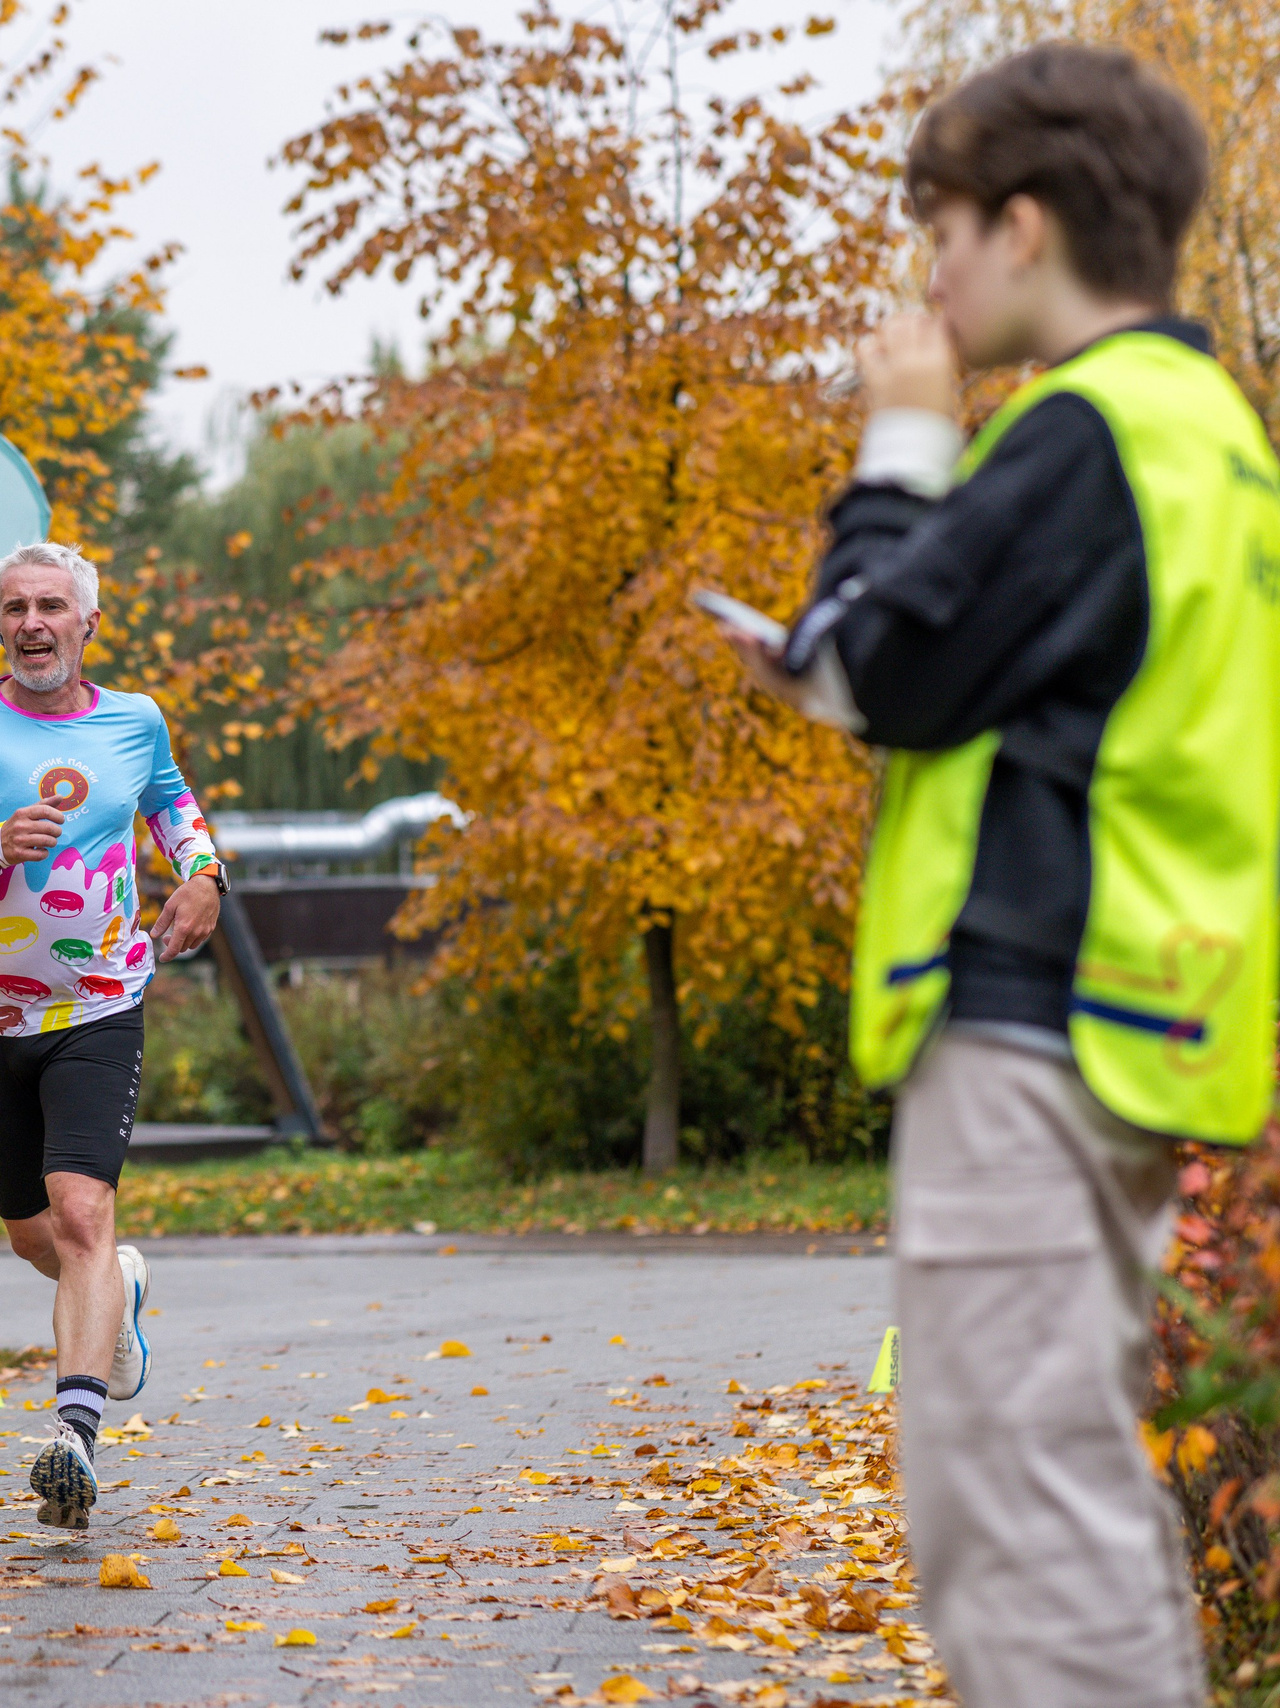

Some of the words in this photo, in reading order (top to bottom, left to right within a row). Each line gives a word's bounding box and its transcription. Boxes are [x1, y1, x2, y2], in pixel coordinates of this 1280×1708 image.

[28, 757, 64, 785] ПОНЧИК
[67, 758, 99, 784] ПАРТИ
[119, 1050, 142, 1138] RUNING
